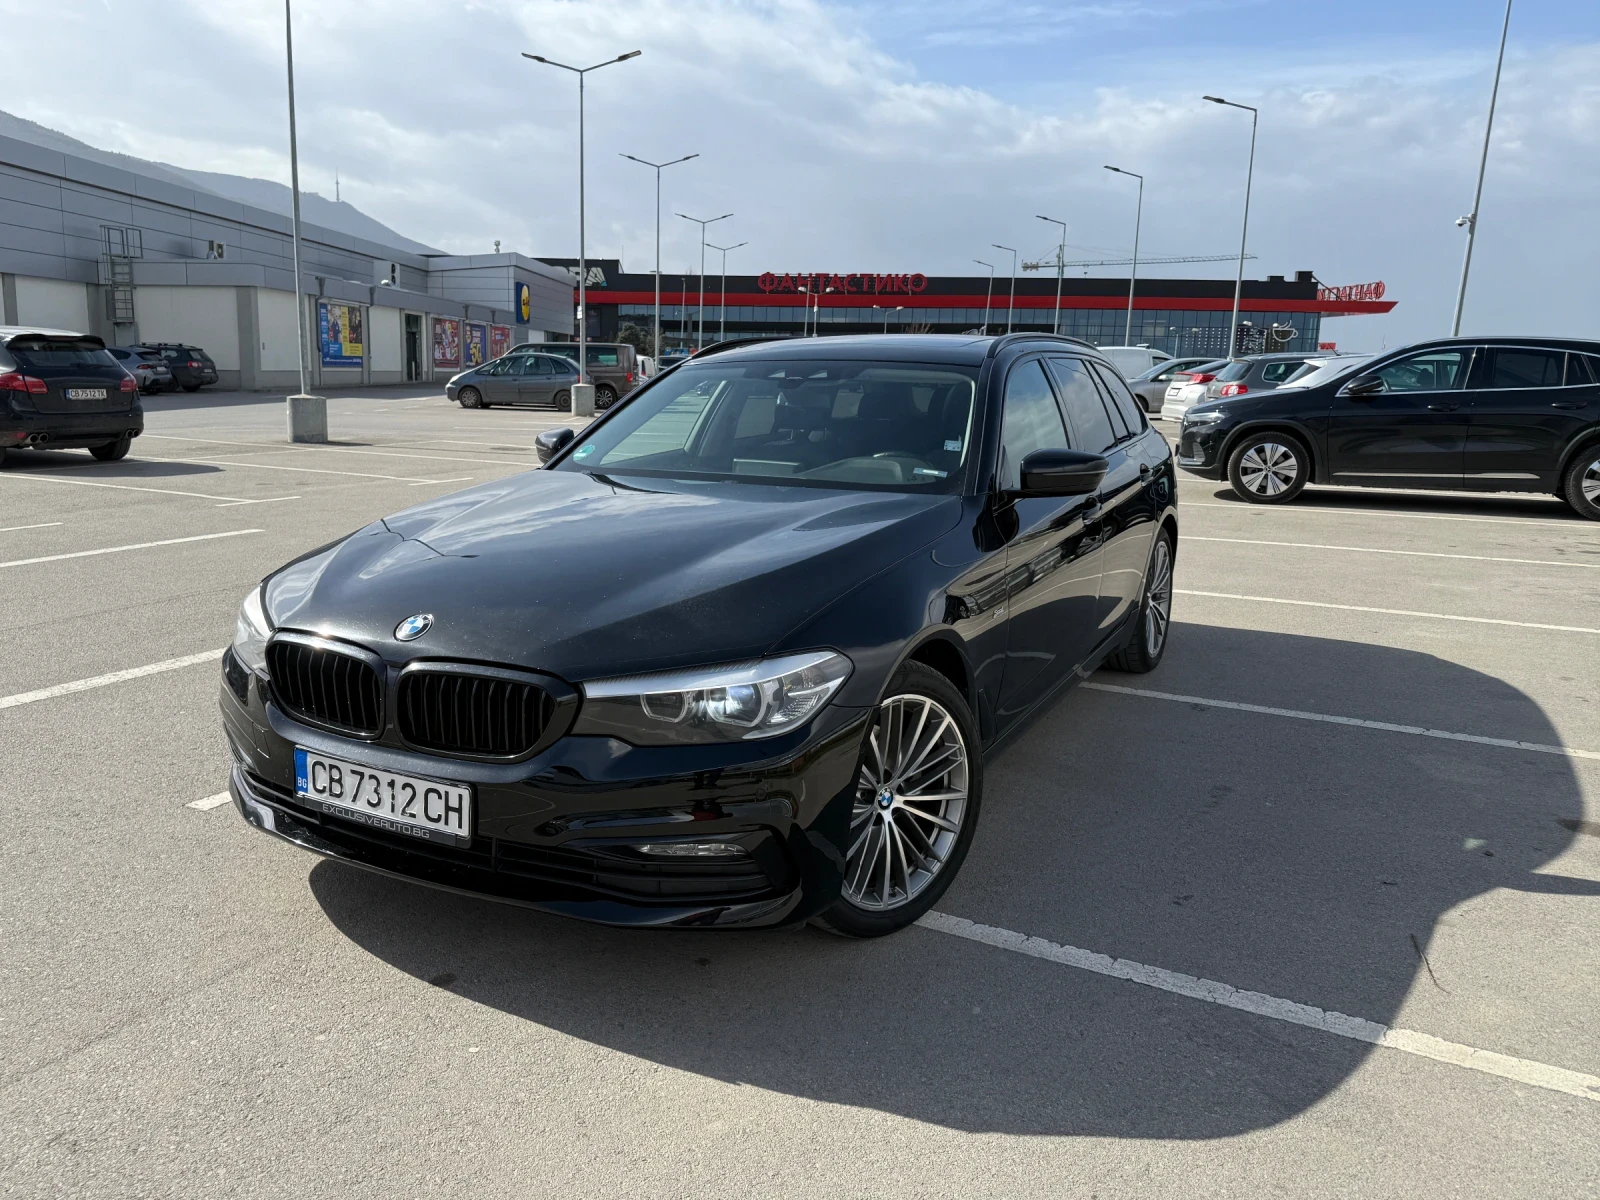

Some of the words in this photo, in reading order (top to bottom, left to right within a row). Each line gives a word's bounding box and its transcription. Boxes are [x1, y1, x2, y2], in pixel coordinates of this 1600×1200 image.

[757, 272, 928, 293] ФАНТАСТИКО
[298, 776, 308, 789] BG
[311, 760, 344, 799] CB
[350, 769, 417, 819] 7312
[423, 787, 463, 830] CH
